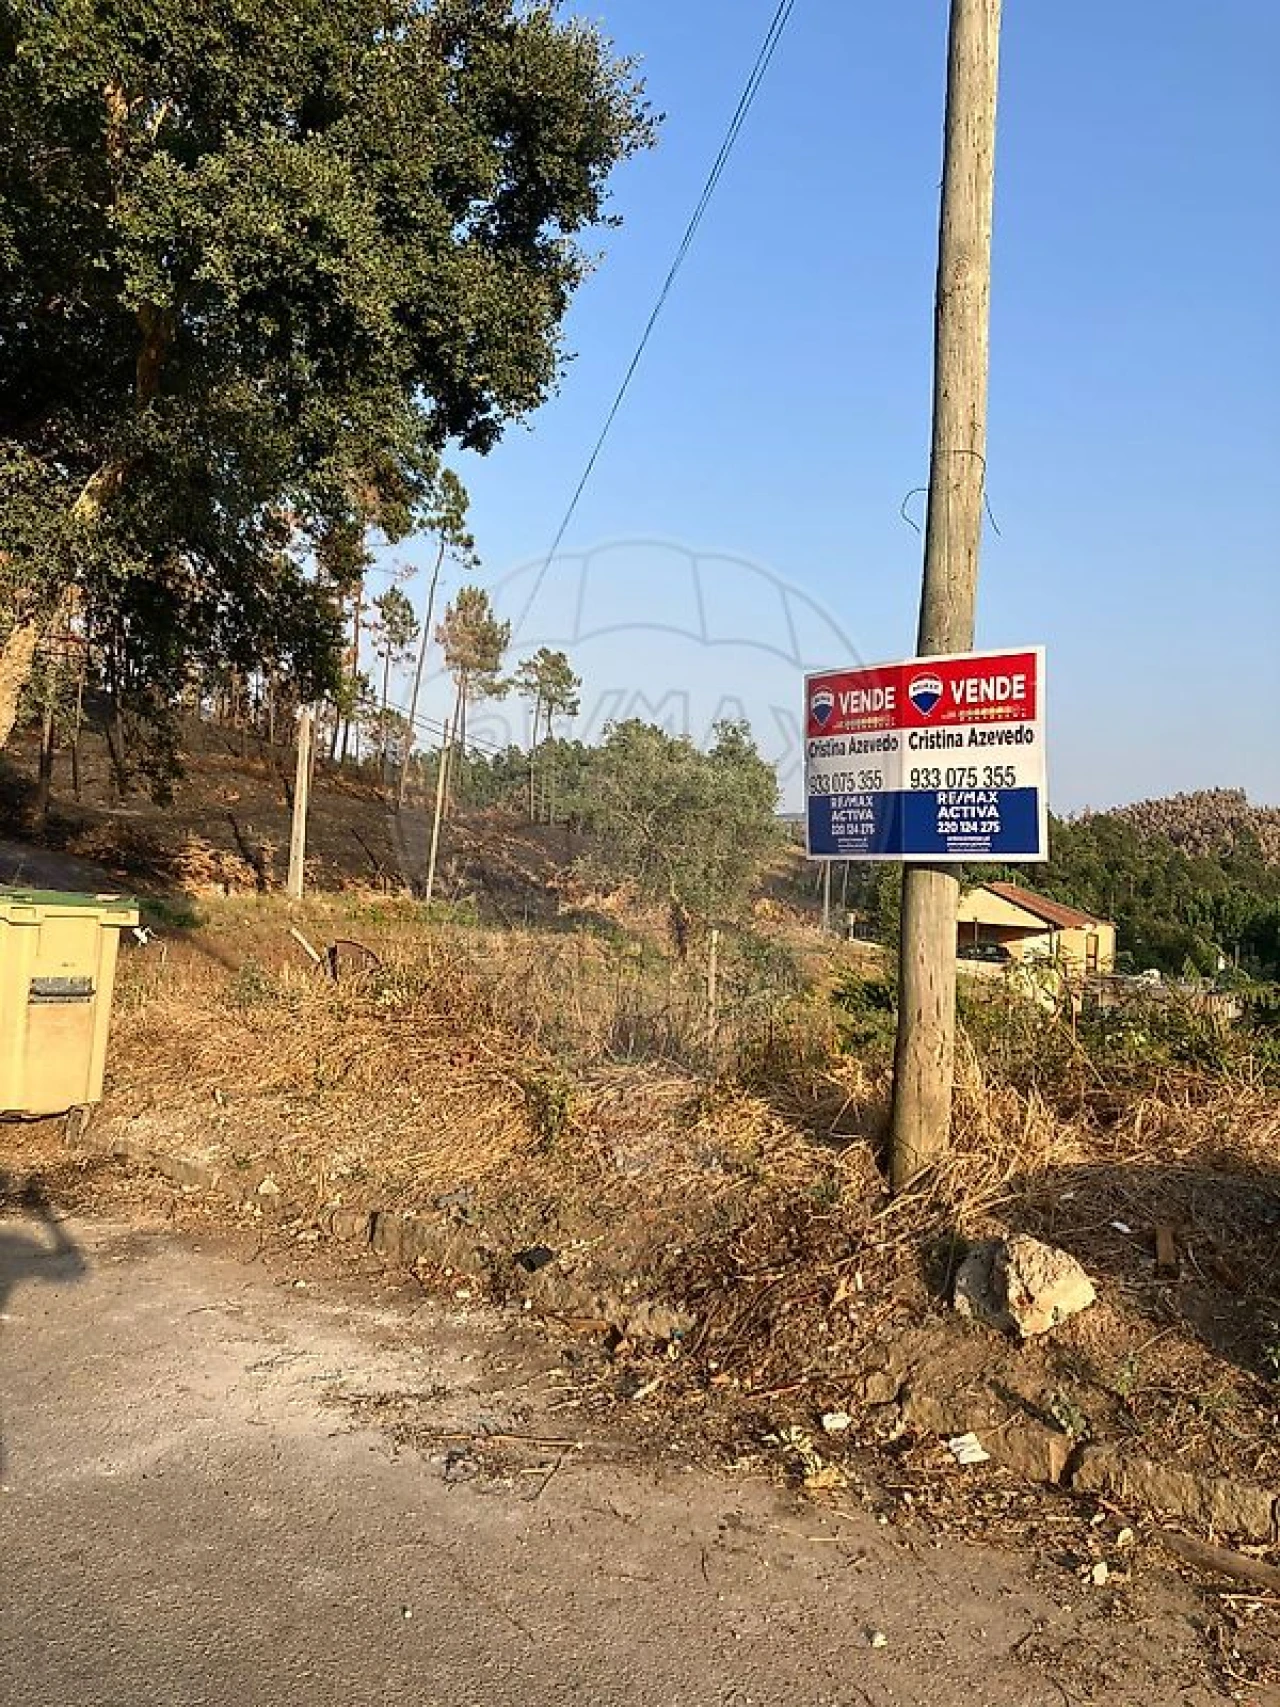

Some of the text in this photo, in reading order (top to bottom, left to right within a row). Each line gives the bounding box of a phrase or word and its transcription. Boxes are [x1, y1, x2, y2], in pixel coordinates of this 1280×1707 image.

[838, 686, 897, 715] VENDE
[950, 673, 1027, 705] VENDE
[809, 733, 899, 758] Cristina Azevedo
[908, 724, 1035, 751] Cristina Azevedo
[832, 771, 856, 792] 075
[858, 769, 882, 790] 355
[910, 765, 1017, 789] 933 075 355
[937, 791, 999, 805] RE/MAX
[831, 808, 875, 822] ACTIVA
[937, 805, 1000, 819] ACTIVA
